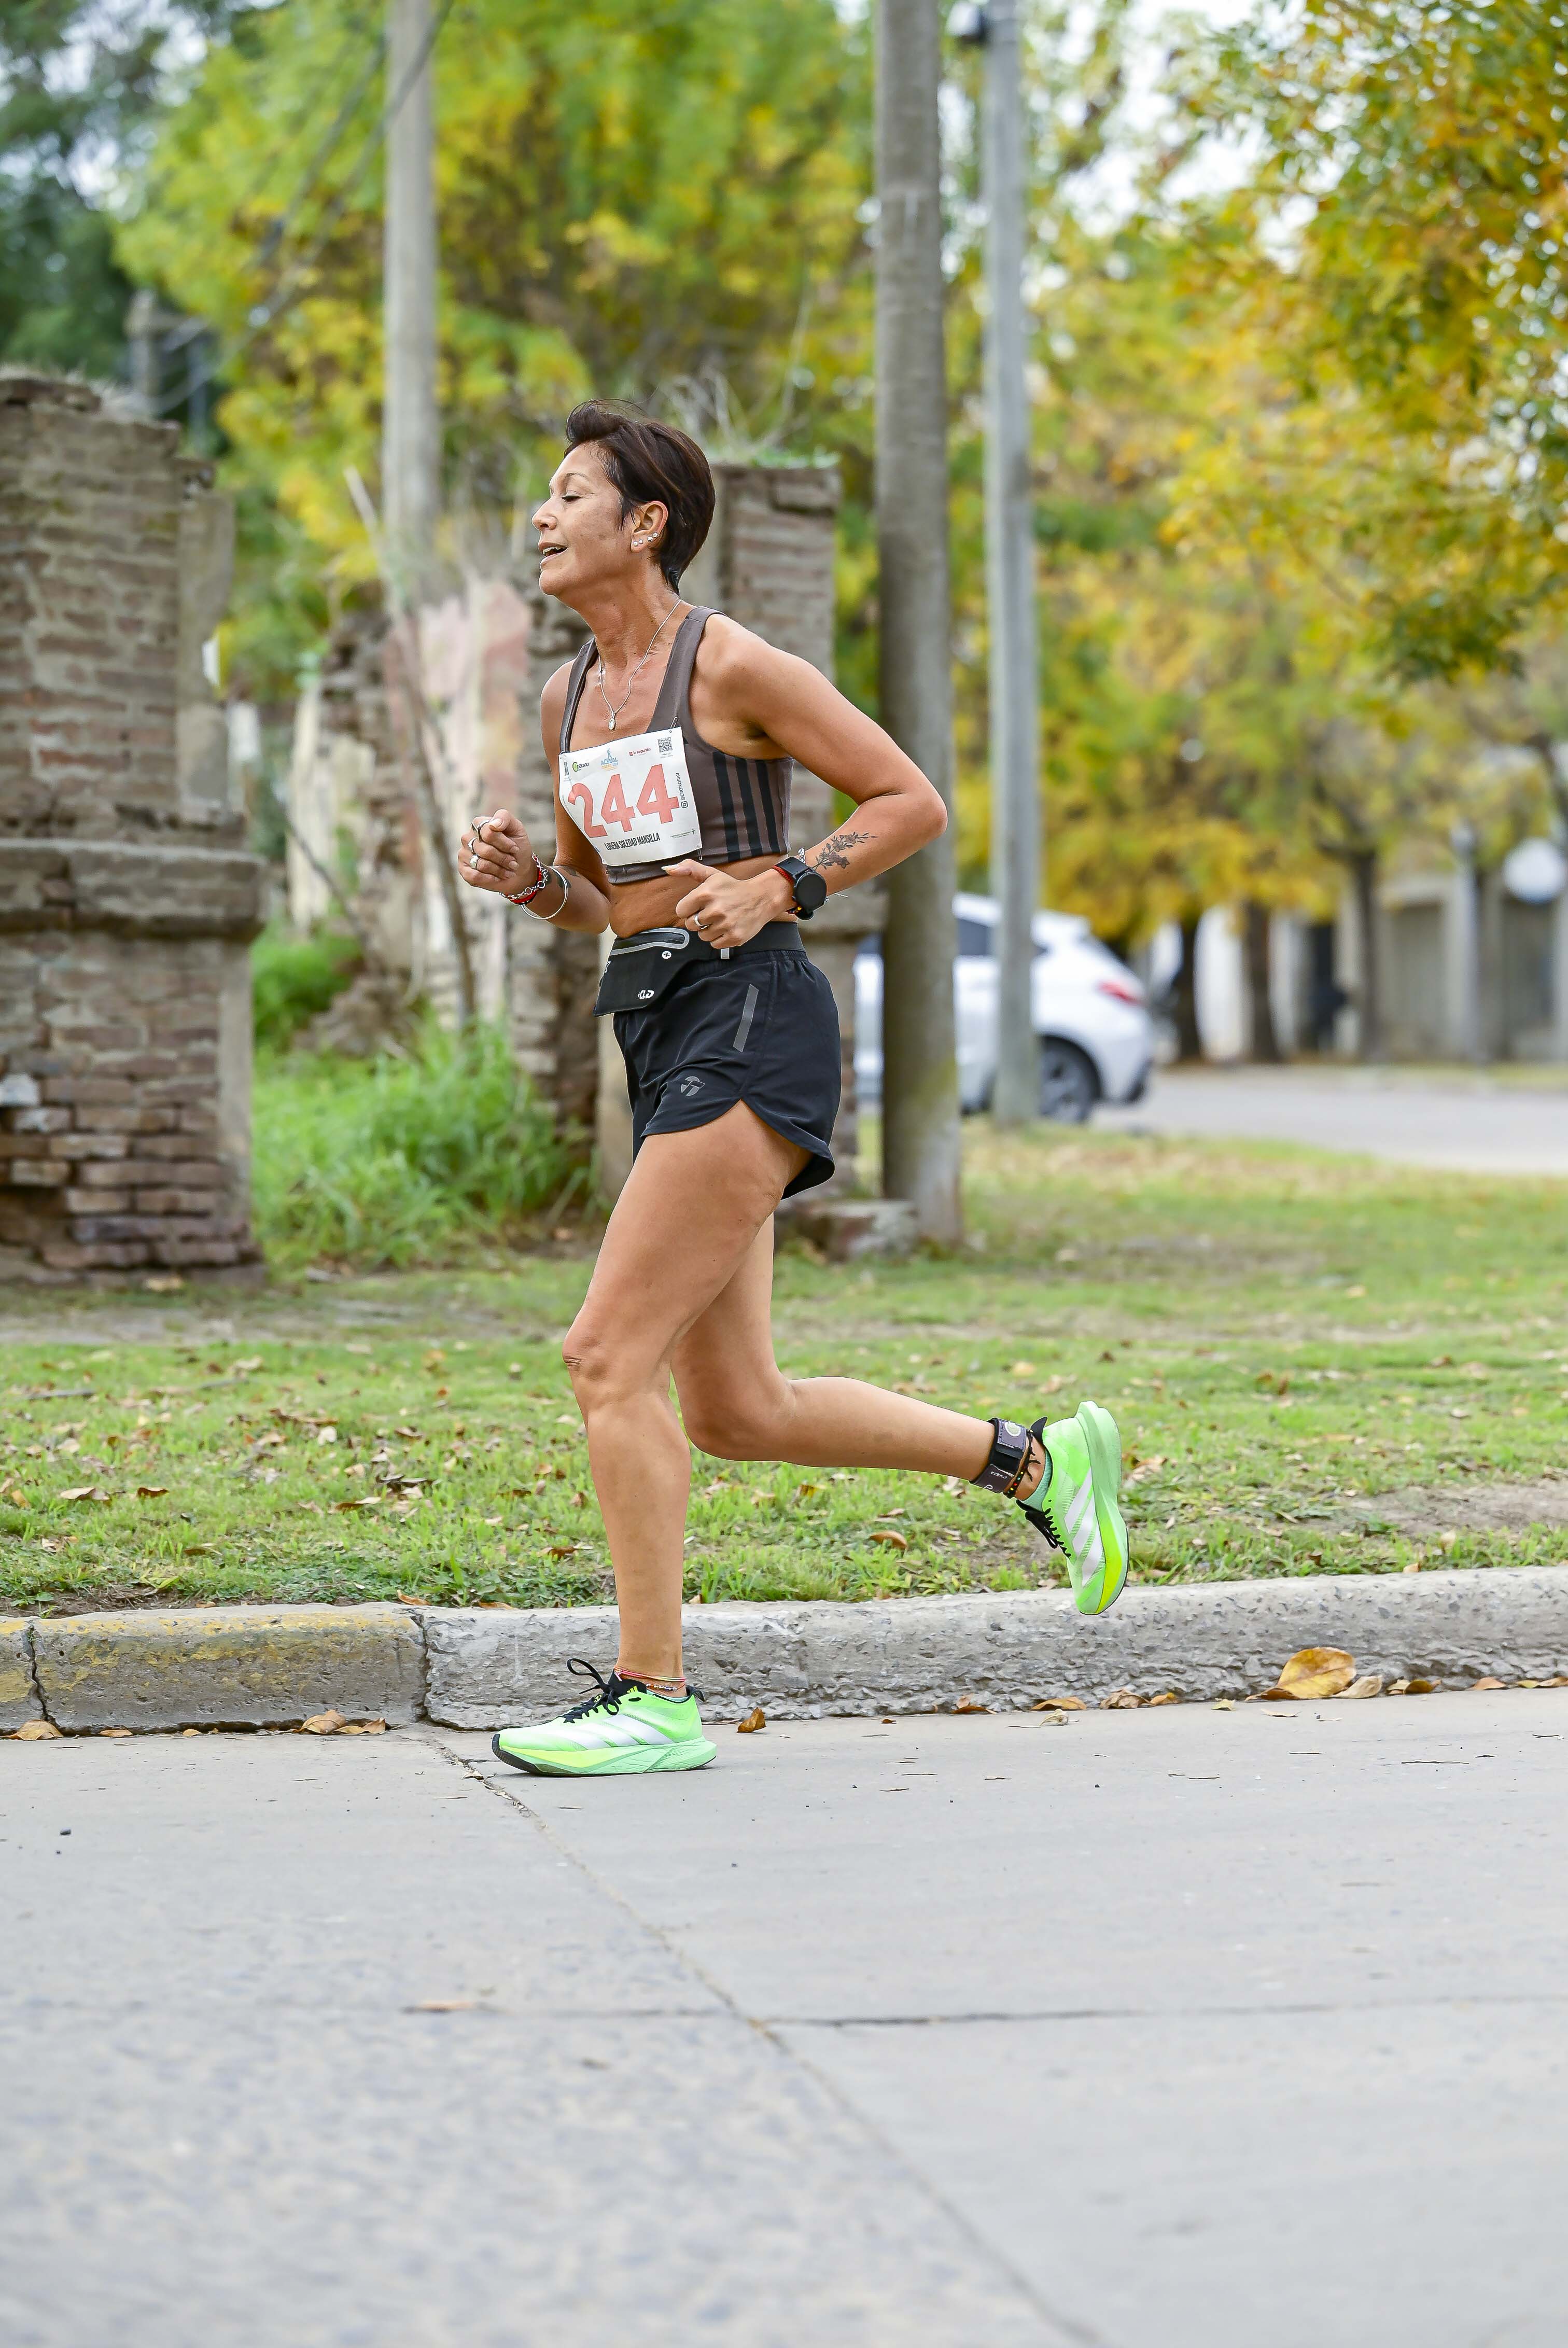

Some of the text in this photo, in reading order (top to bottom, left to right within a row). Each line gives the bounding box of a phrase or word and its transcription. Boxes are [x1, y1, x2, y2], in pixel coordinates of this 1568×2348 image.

[676, 773, 685, 800] @CRONORAV
[568, 764, 680, 838] 244
[604, 841, 621, 850] LORENA
[619, 837, 638, 849] SOLEDAD
[637, 832, 661, 845] MANSILLA
